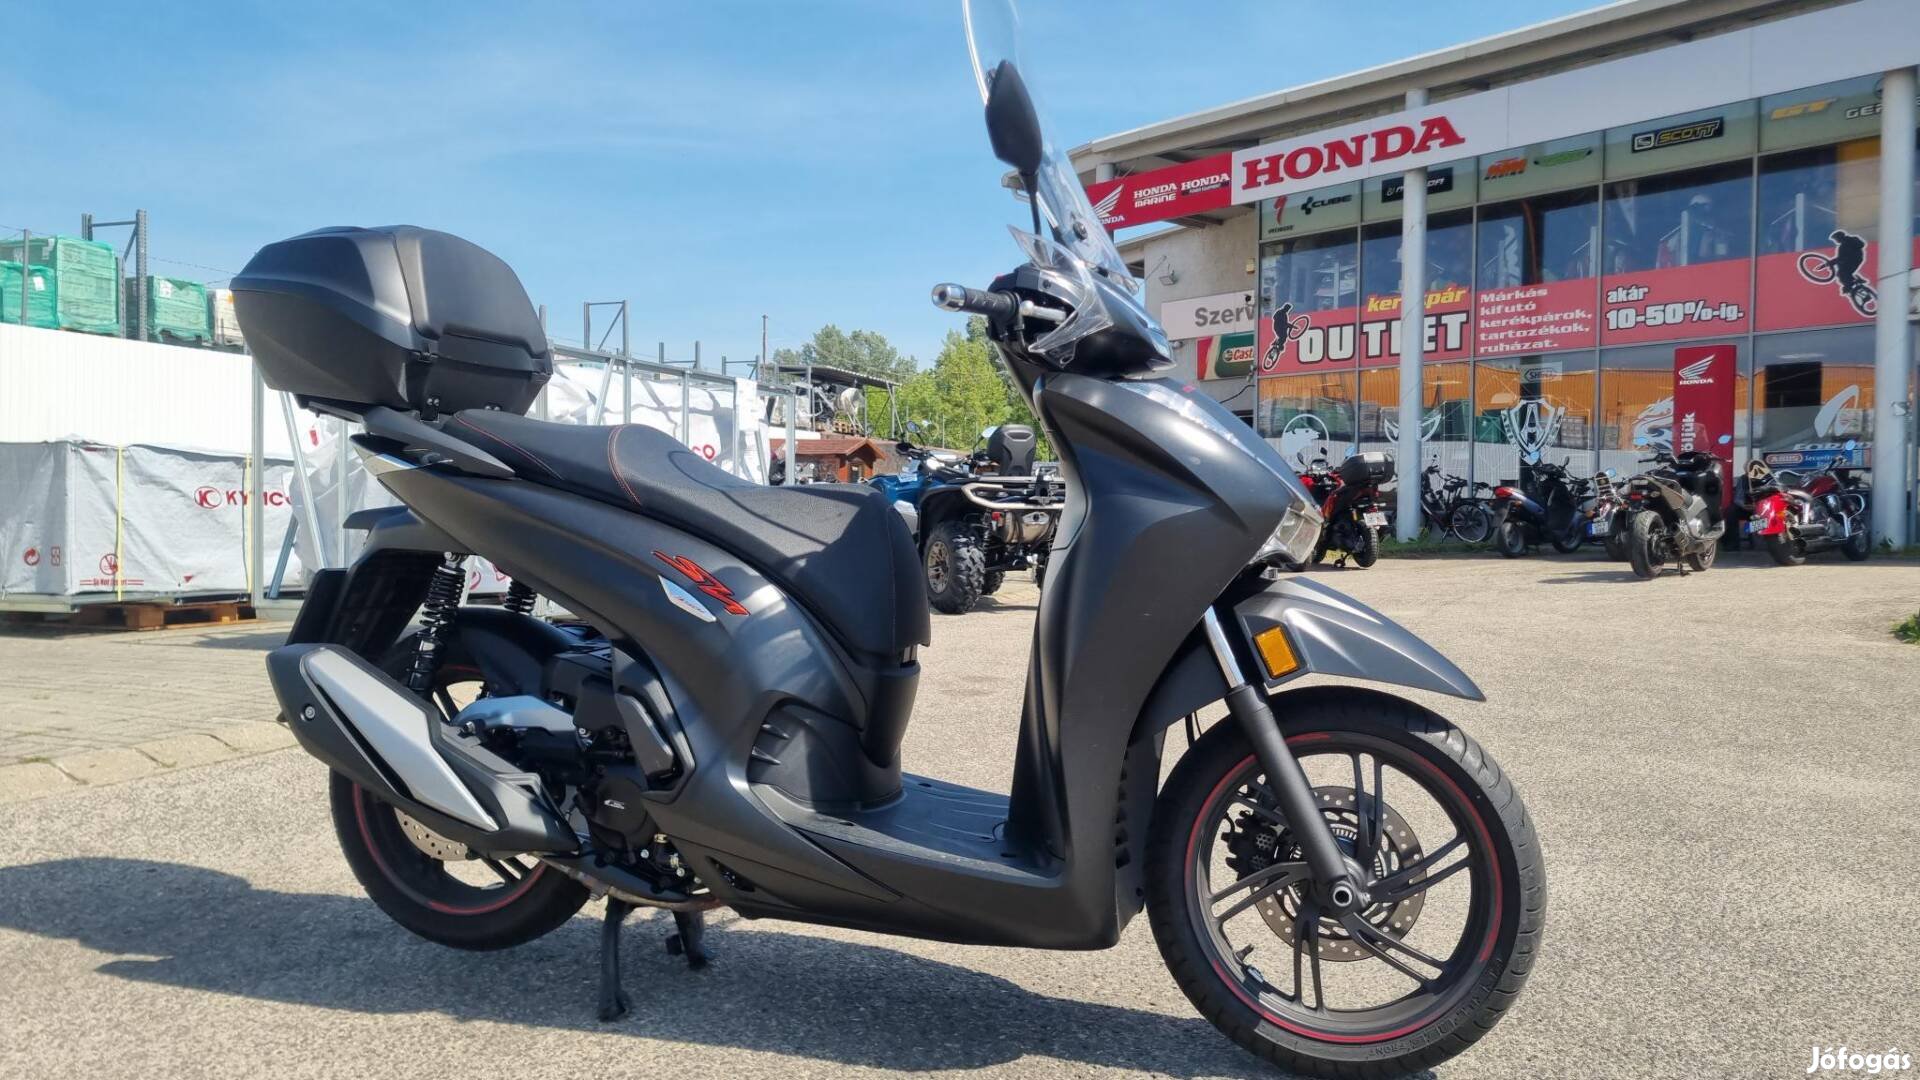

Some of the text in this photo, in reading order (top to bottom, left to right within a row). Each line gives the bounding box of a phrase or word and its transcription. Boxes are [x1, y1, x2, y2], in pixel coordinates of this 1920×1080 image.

[1660, 121, 1721, 142] SCOTT
[1242, 116, 1465, 190] HONDA
[1134, 183, 1177, 198] HONDA
[1181, 173, 1230, 191] HONDA
[1135, 193, 1176, 208] MARINE
[1368, 287, 1467, 312] kerpár
[1480, 288, 1547, 303] Márkás
[1607, 285, 1648, 303] akár
[1480, 301, 1536, 316] kifutó
[1606, 301, 1744, 330] 10-50%-ig.
[1480, 340, 1559, 353] ruházat.
